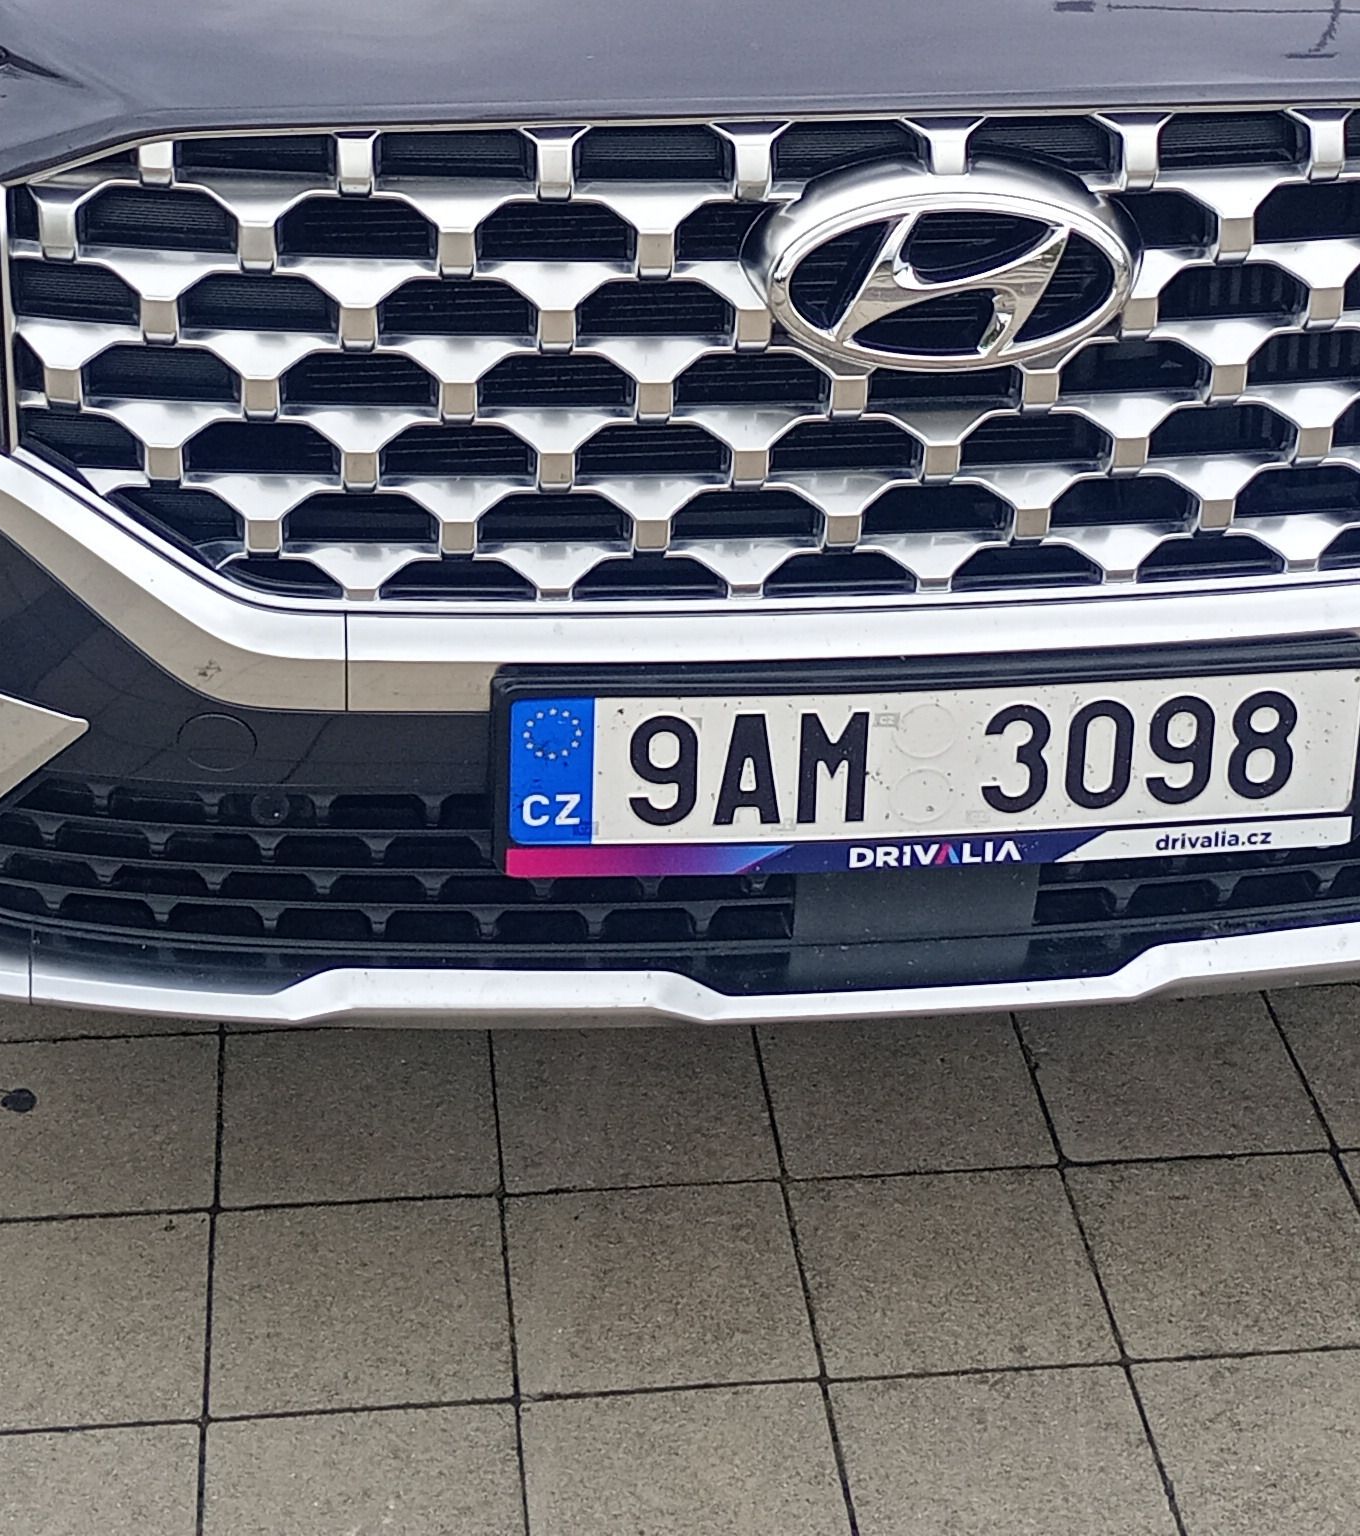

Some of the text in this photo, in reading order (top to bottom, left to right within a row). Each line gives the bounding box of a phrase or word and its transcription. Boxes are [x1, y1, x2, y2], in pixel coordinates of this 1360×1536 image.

[522, 690, 1298, 827] CZ 9AM 3098
[848, 828, 1272, 869] DRIVALIA drivalia.cz
